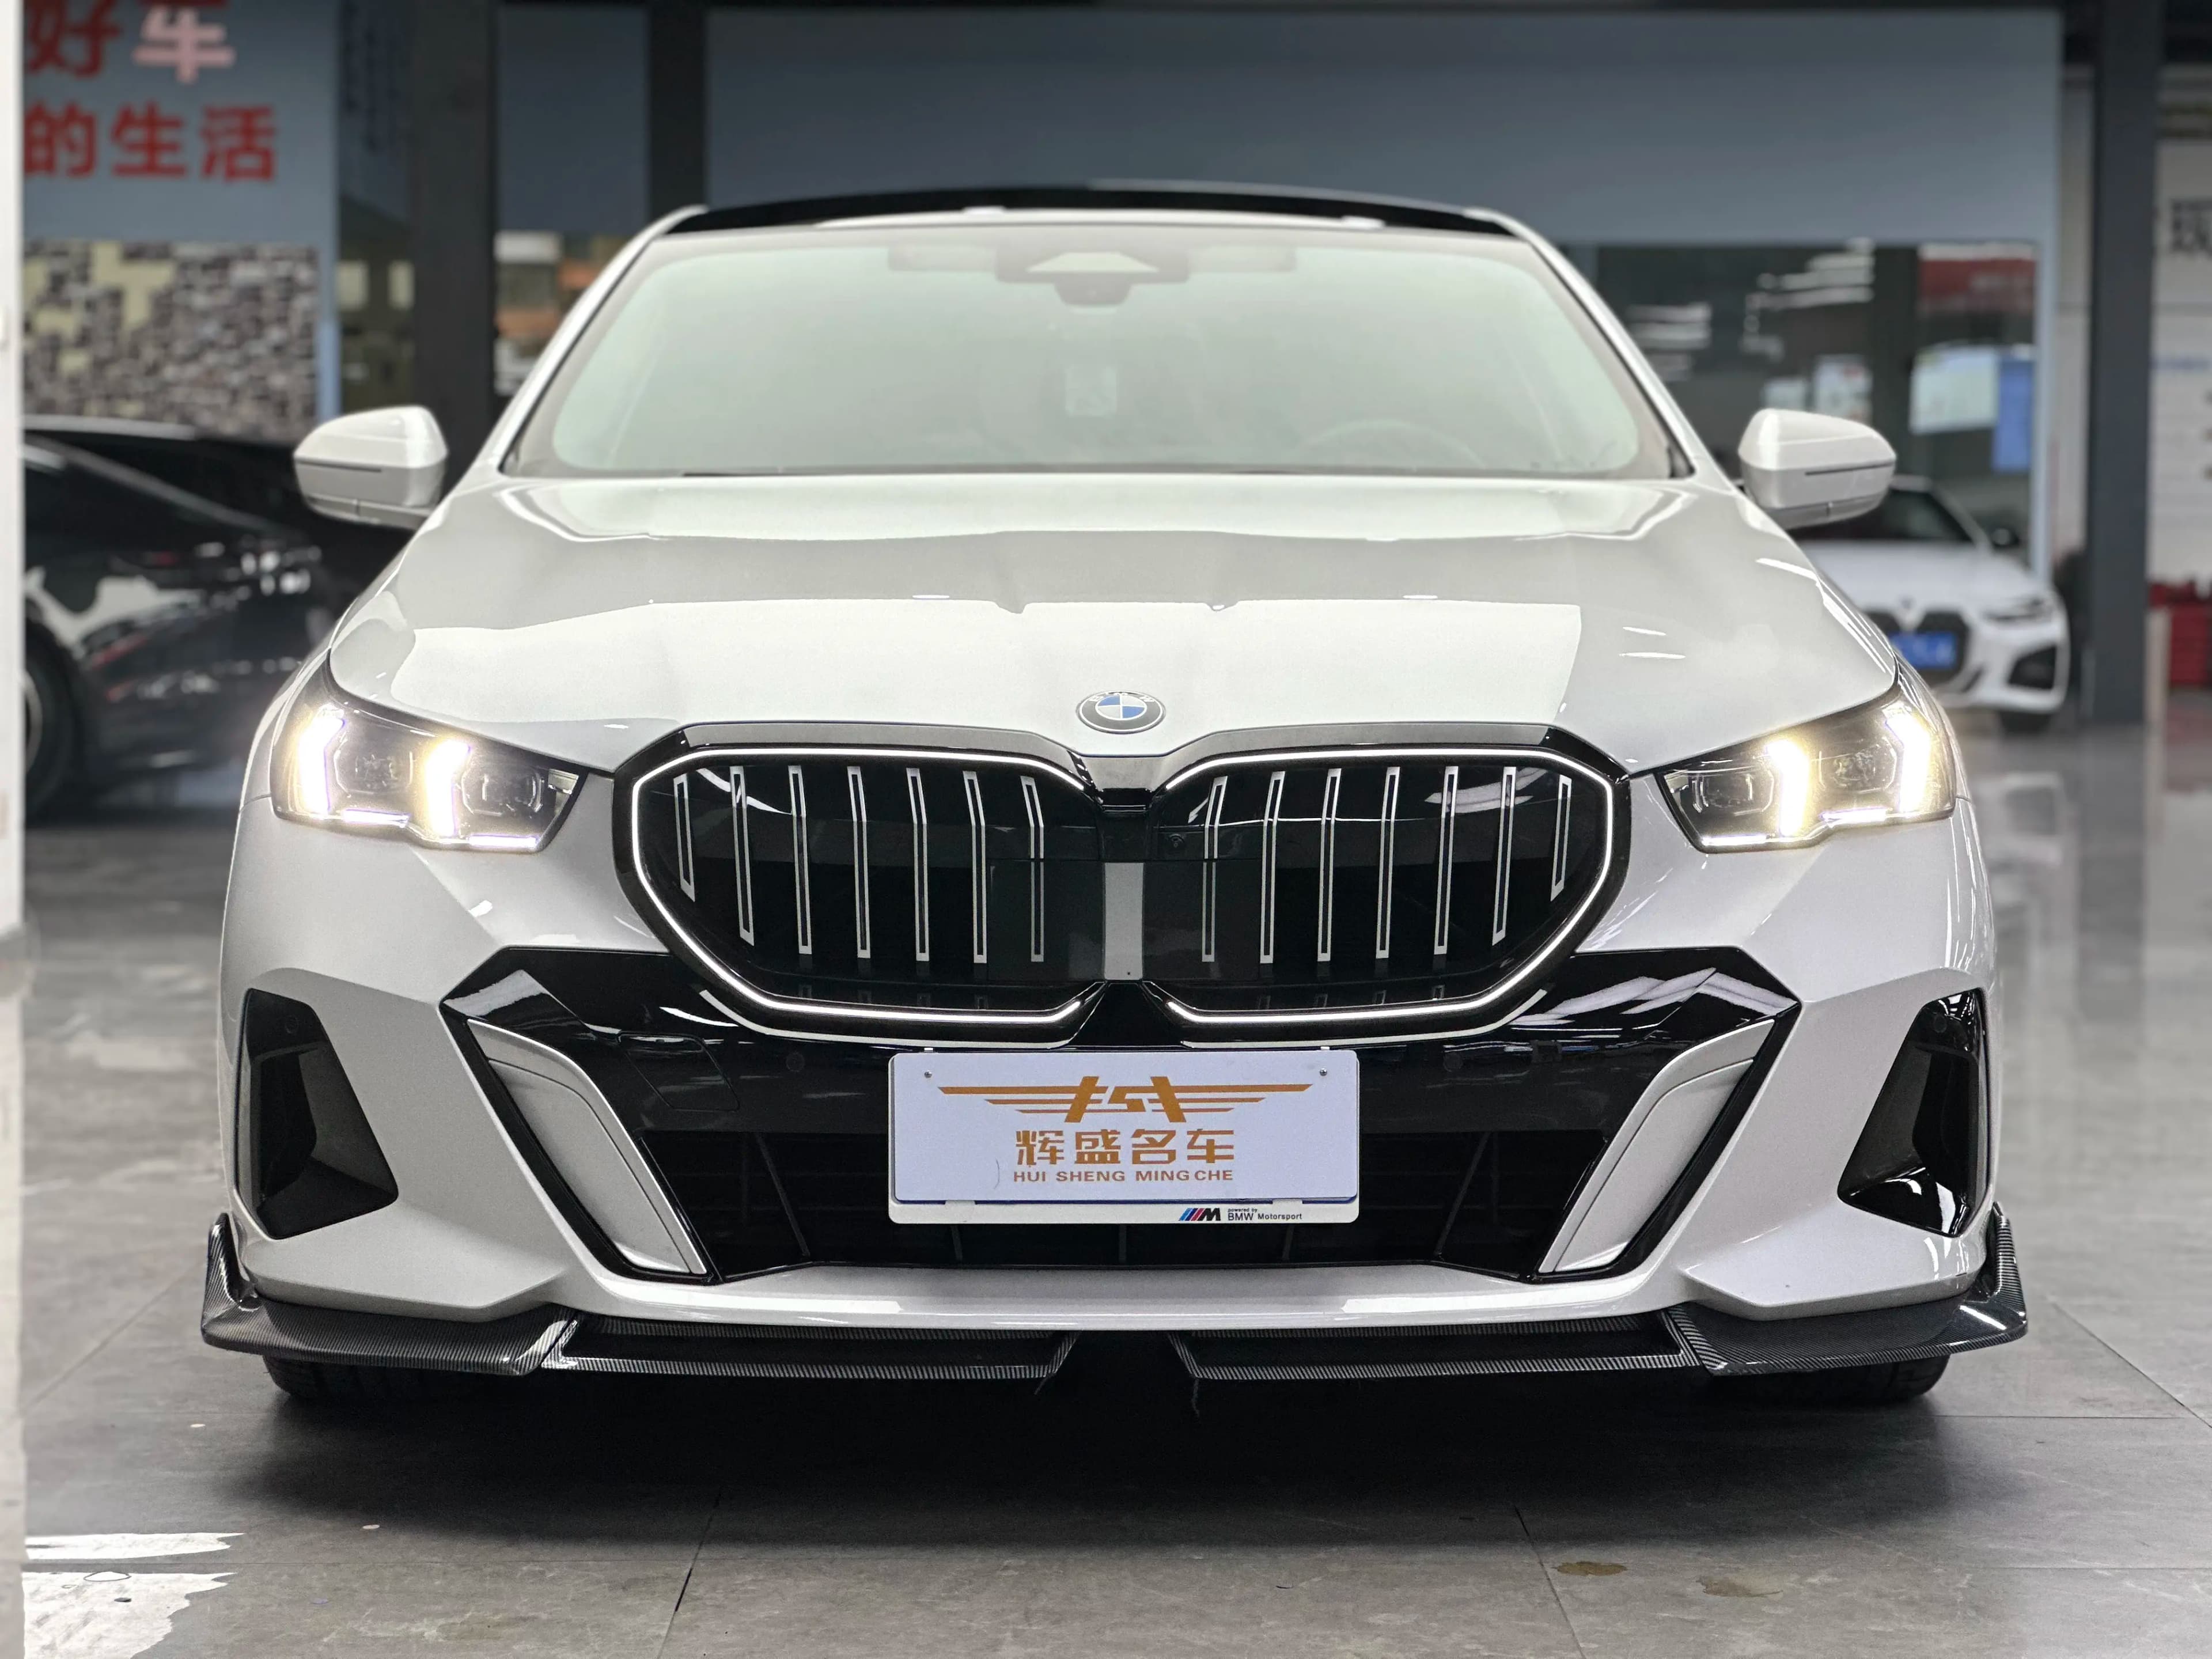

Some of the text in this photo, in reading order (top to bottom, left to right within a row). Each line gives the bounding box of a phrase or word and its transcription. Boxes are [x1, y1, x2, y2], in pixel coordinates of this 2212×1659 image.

[24, 100, 275, 181] 的生活
[1016, 1128, 1234, 1165] 辉盛名车
[1013, 1169, 1234, 1182] HUI SHENG MING CHE
[1228, 1213, 1303, 1221] BMW Motorsport
